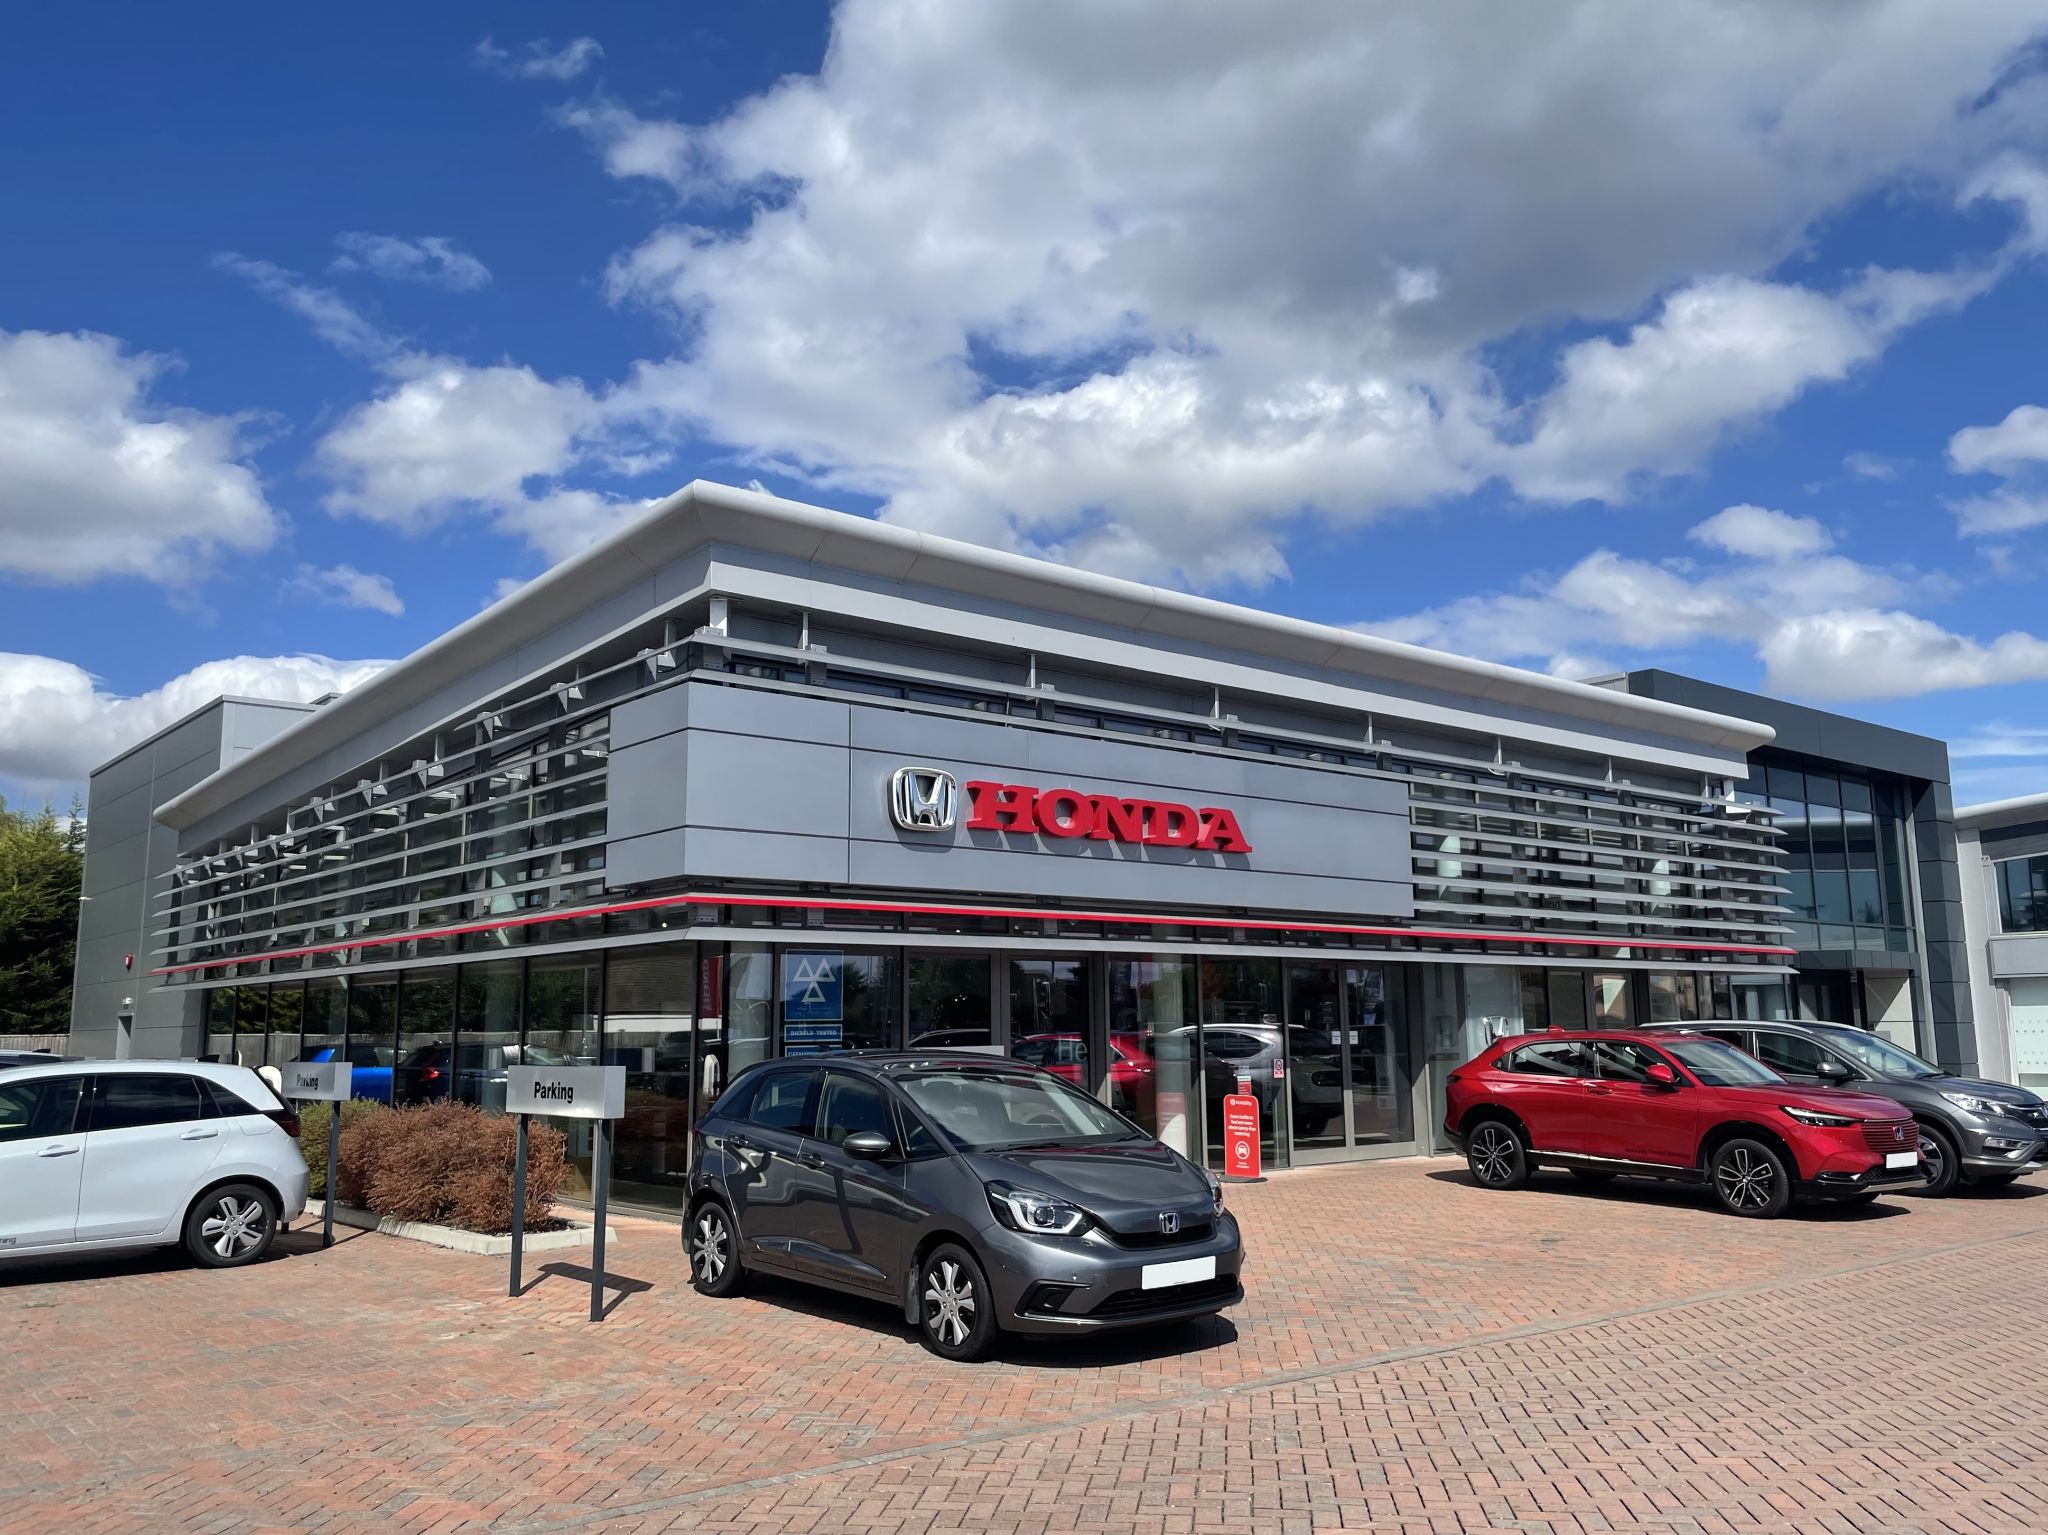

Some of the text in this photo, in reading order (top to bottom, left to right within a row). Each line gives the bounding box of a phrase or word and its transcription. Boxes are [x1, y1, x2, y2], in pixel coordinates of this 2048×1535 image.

[966, 780, 1252, 853] HONDA
[296, 1073, 319, 1090] Parking
[534, 1081, 574, 1104] Parking
